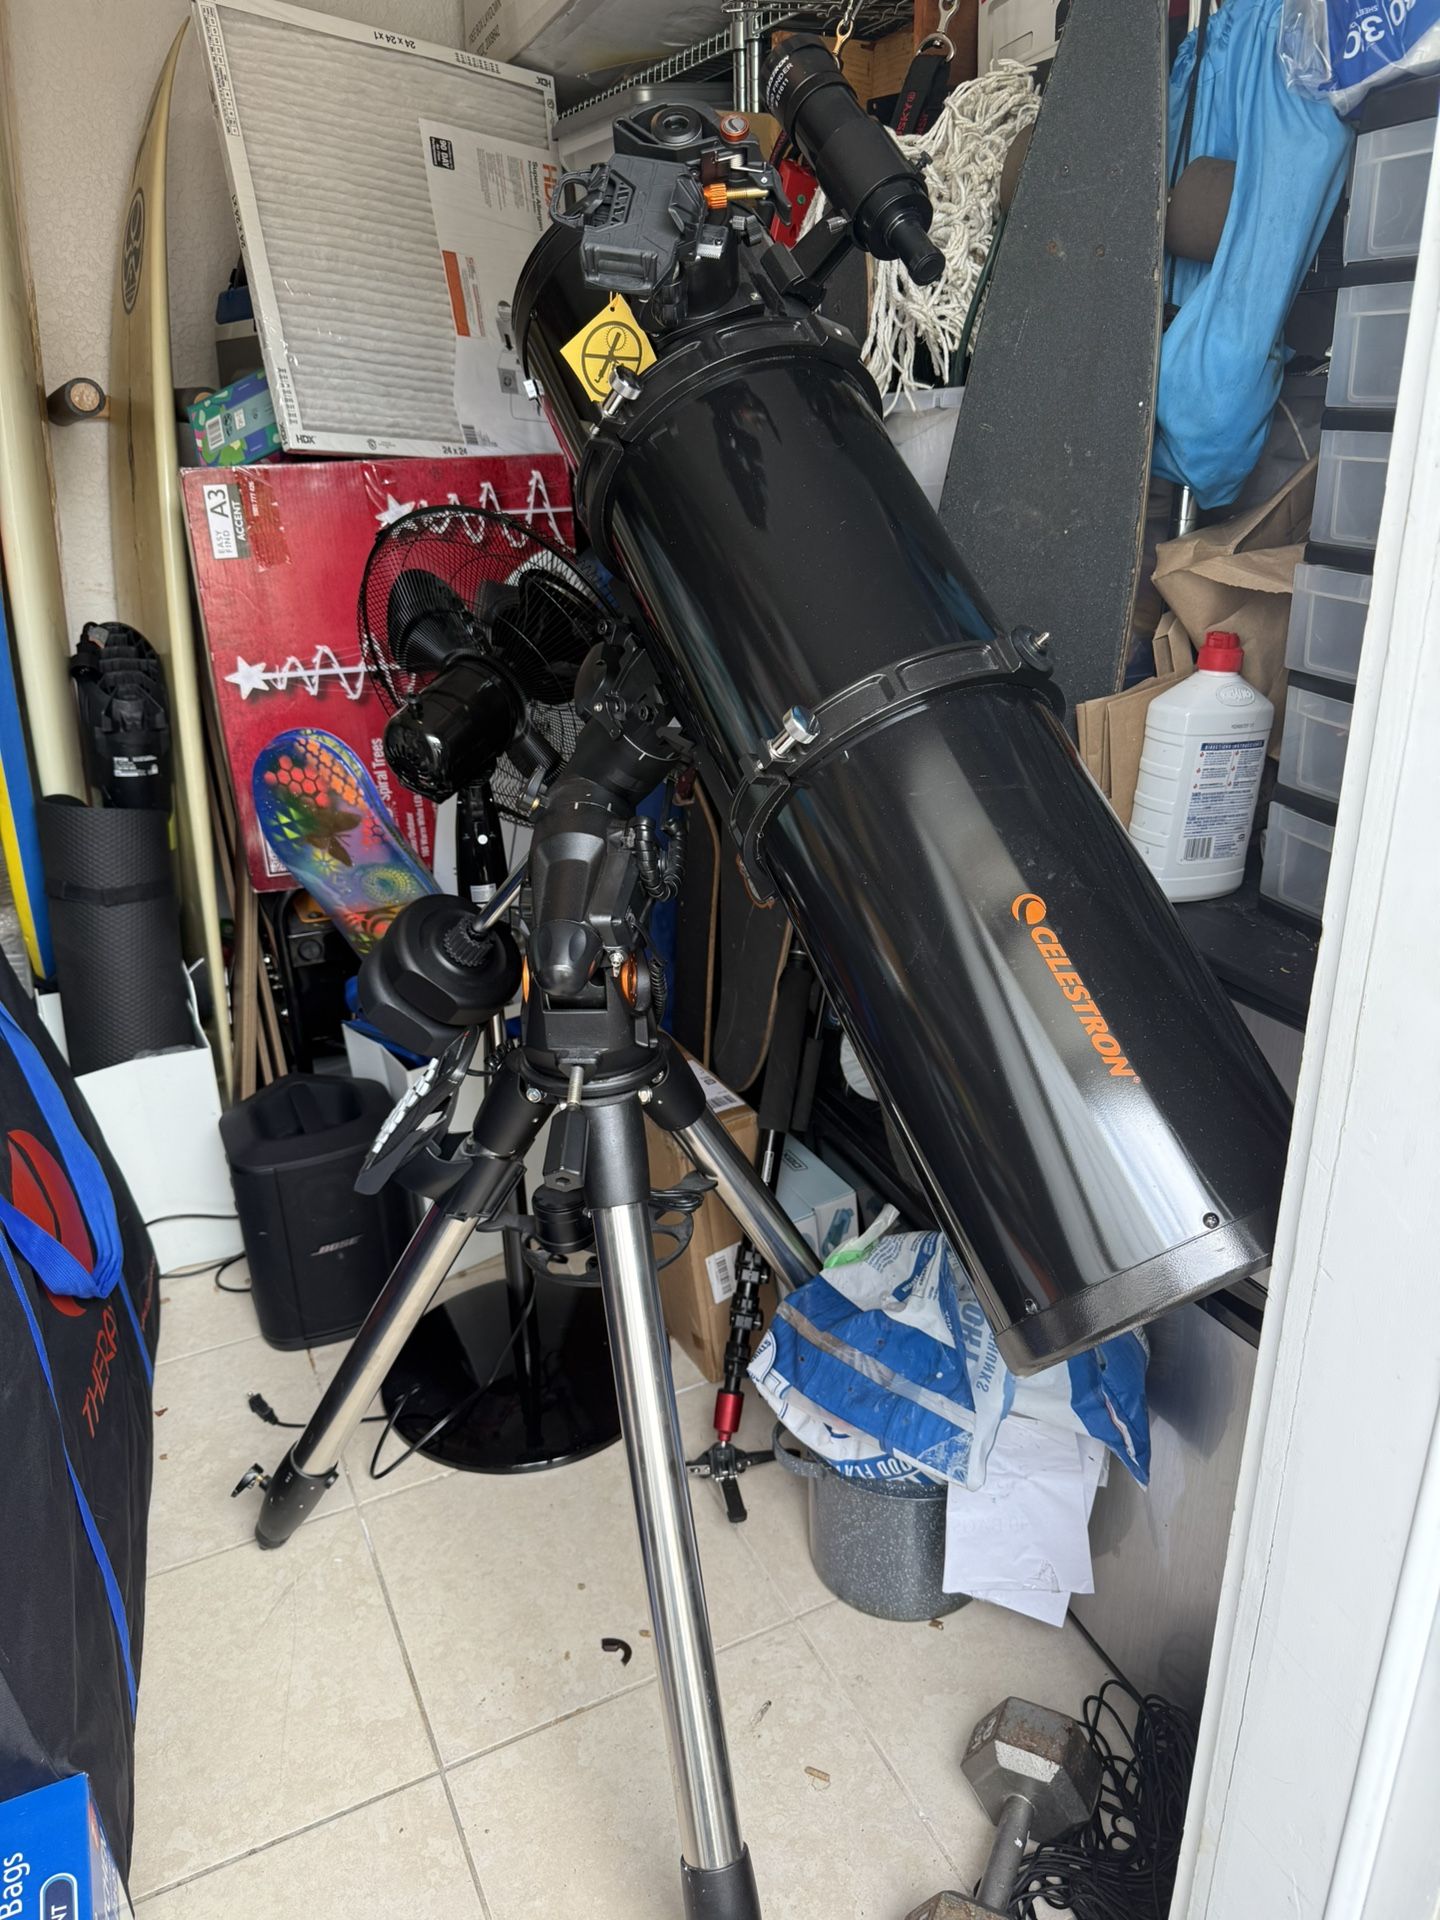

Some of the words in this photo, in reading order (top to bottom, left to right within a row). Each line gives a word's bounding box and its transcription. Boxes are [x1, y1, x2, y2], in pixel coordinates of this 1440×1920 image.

[385, 35, 398, 45] 24
[405, 39, 416, 50] 24
[772, 62, 793, 93] FINDER
[296, 434, 316, 445] HDX
[442, 446, 452, 455] 24
[459, 447, 468, 455] 24
[207, 489, 229, 518] A3
[231, 500, 247, 541] ACCENT
[216, 530, 226, 554] EASY
[223, 530, 233, 553] FIND
[371, 738, 386, 769] Trees
[374, 770, 393, 802] Spiral
[311, 1234, 363, 1256] BOSE
[876, 1457, 914, 1476] OOD
